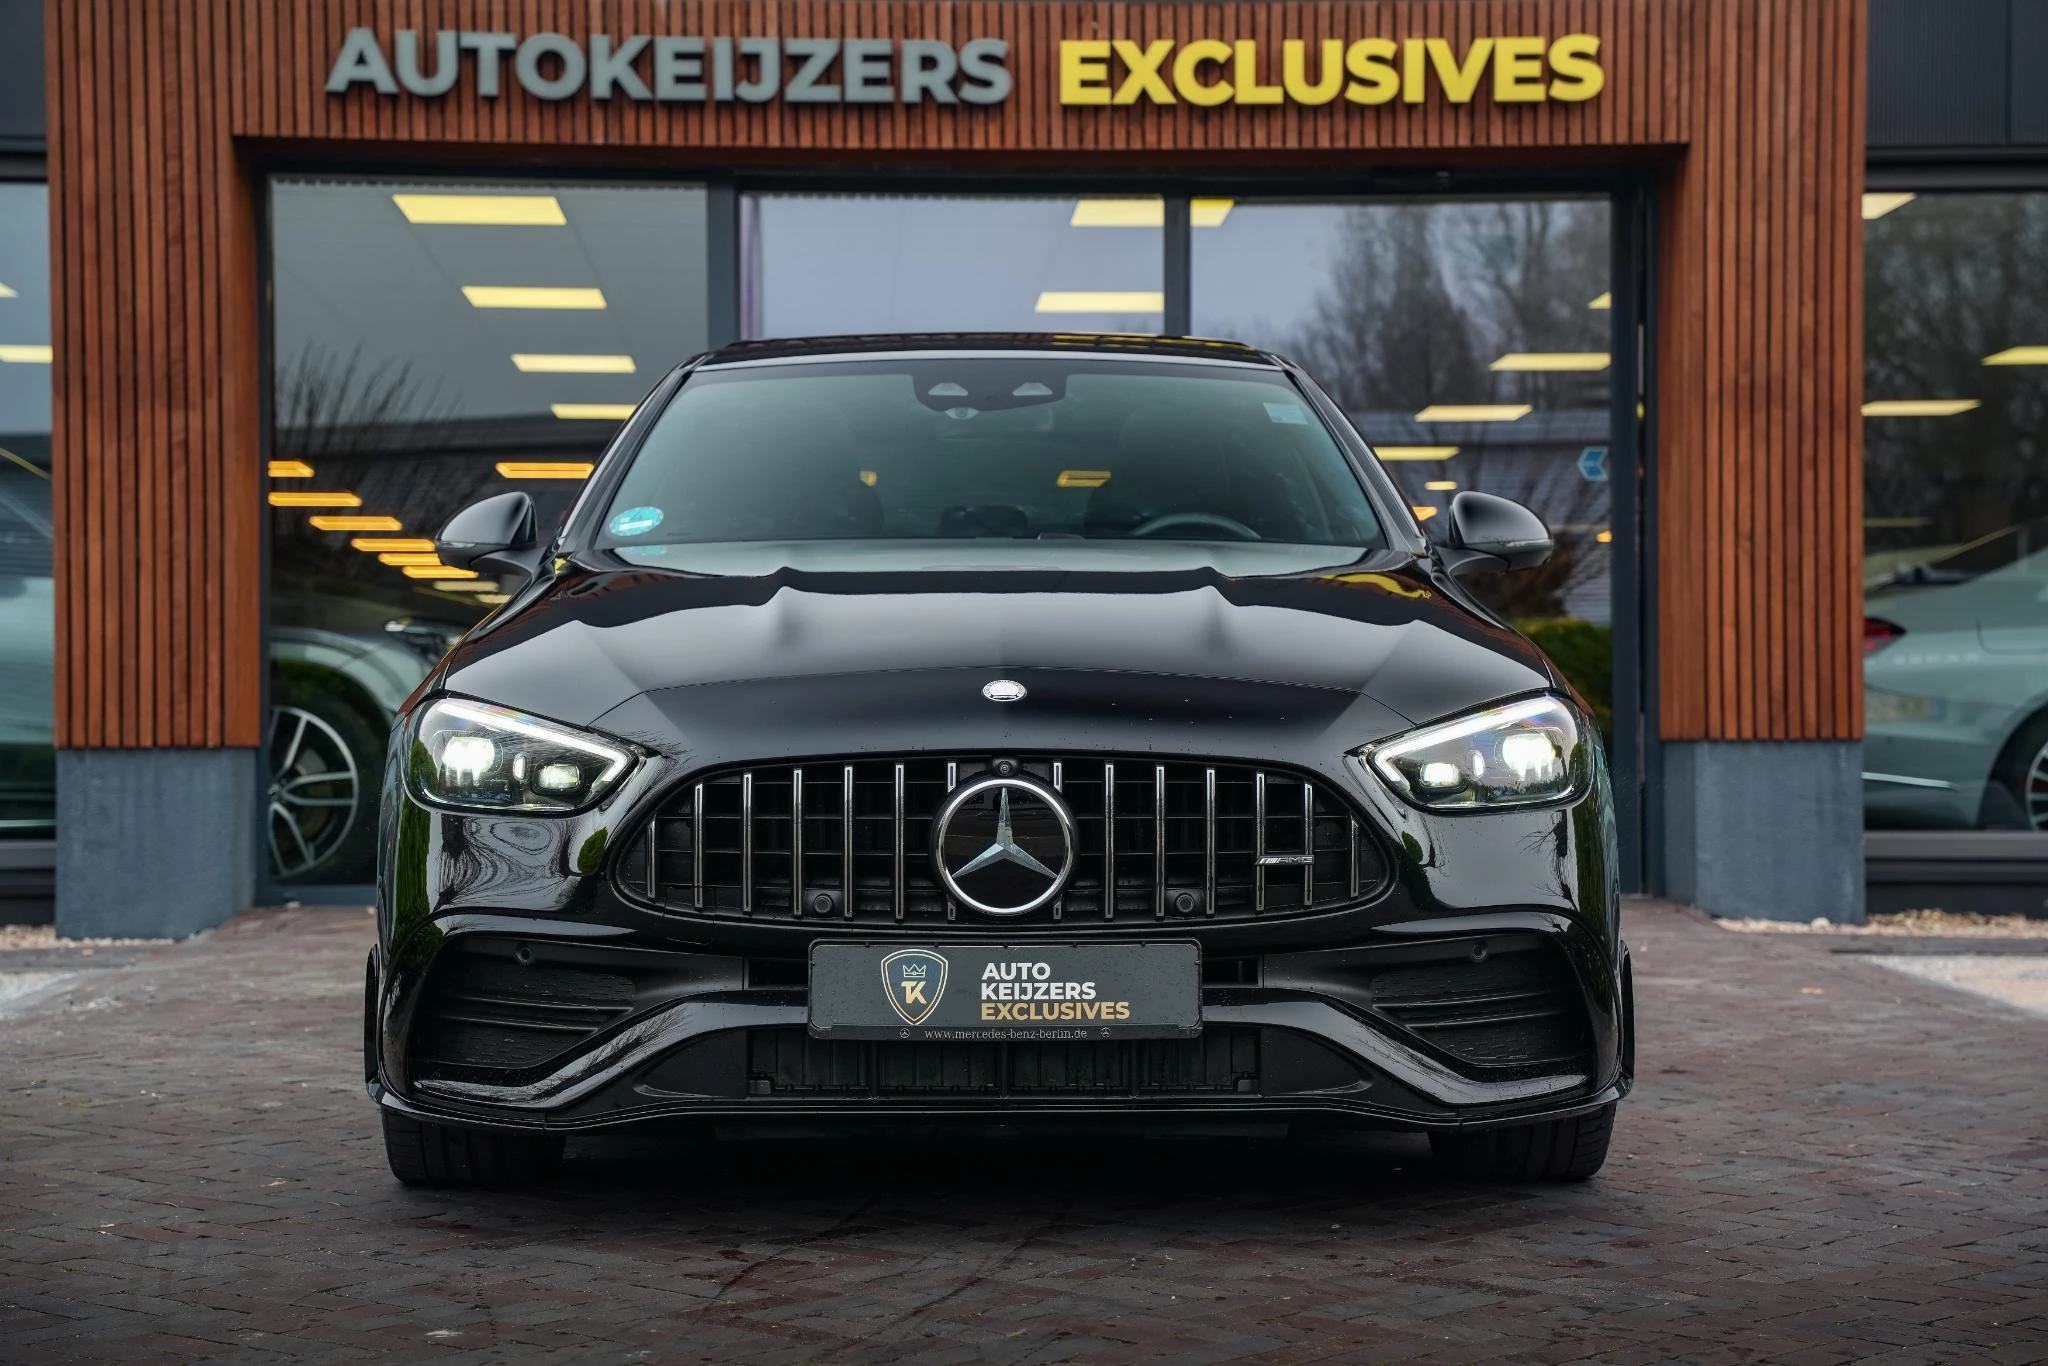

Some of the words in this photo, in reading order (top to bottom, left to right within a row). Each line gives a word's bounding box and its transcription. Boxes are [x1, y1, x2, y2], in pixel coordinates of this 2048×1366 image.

[325, 27, 1013, 103] AUTOKEIJZERS
[1059, 34, 1605, 106] EXCLUSIVES
[981, 962, 1051, 980] AUTO
[981, 982, 1097, 1000] KEIJZERS
[981, 1002, 1130, 1020] EXCLUSIVES
[924, 1028, 1088, 1040] www.mercedes-benz-berlin.de
